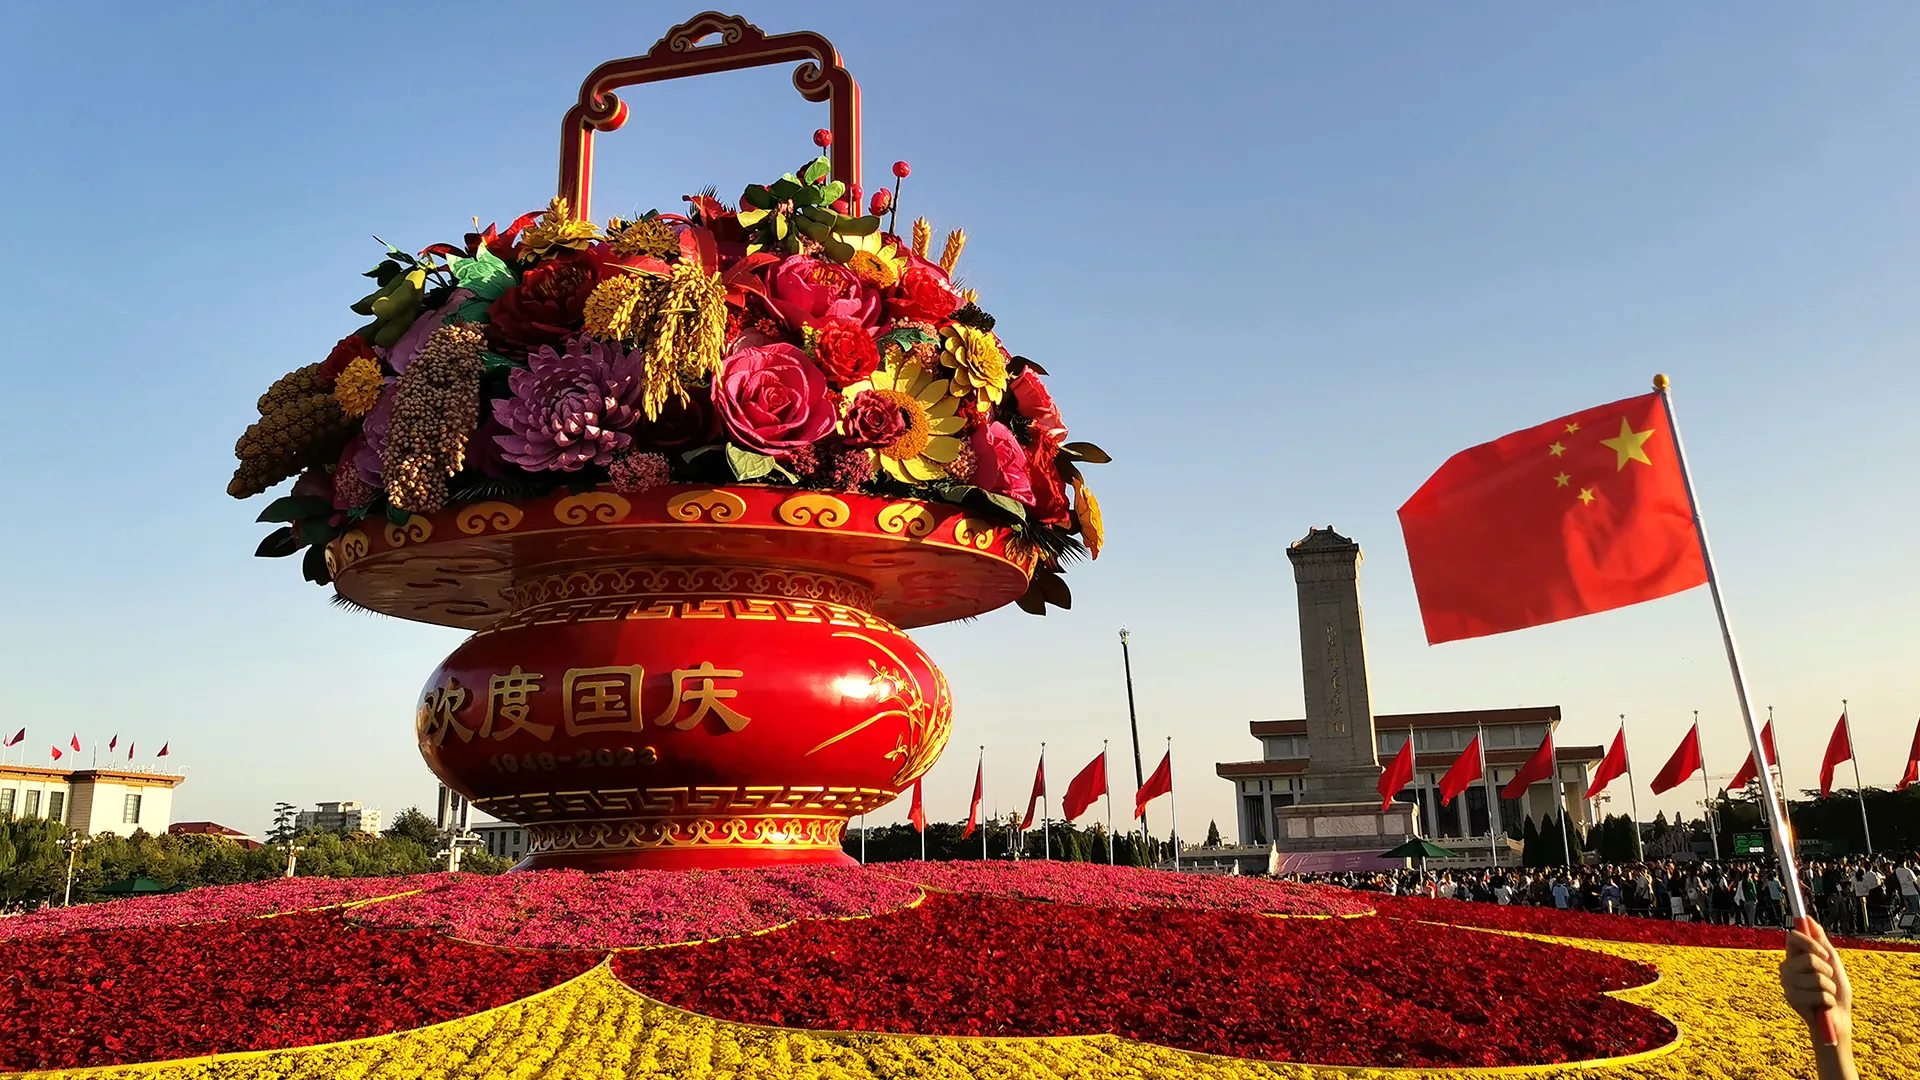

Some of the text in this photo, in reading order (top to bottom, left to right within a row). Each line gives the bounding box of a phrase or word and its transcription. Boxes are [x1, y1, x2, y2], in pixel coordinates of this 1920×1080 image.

[423, 660, 752, 746] 欢度国庆
[489, 746, 658, 773] 1949-2023
